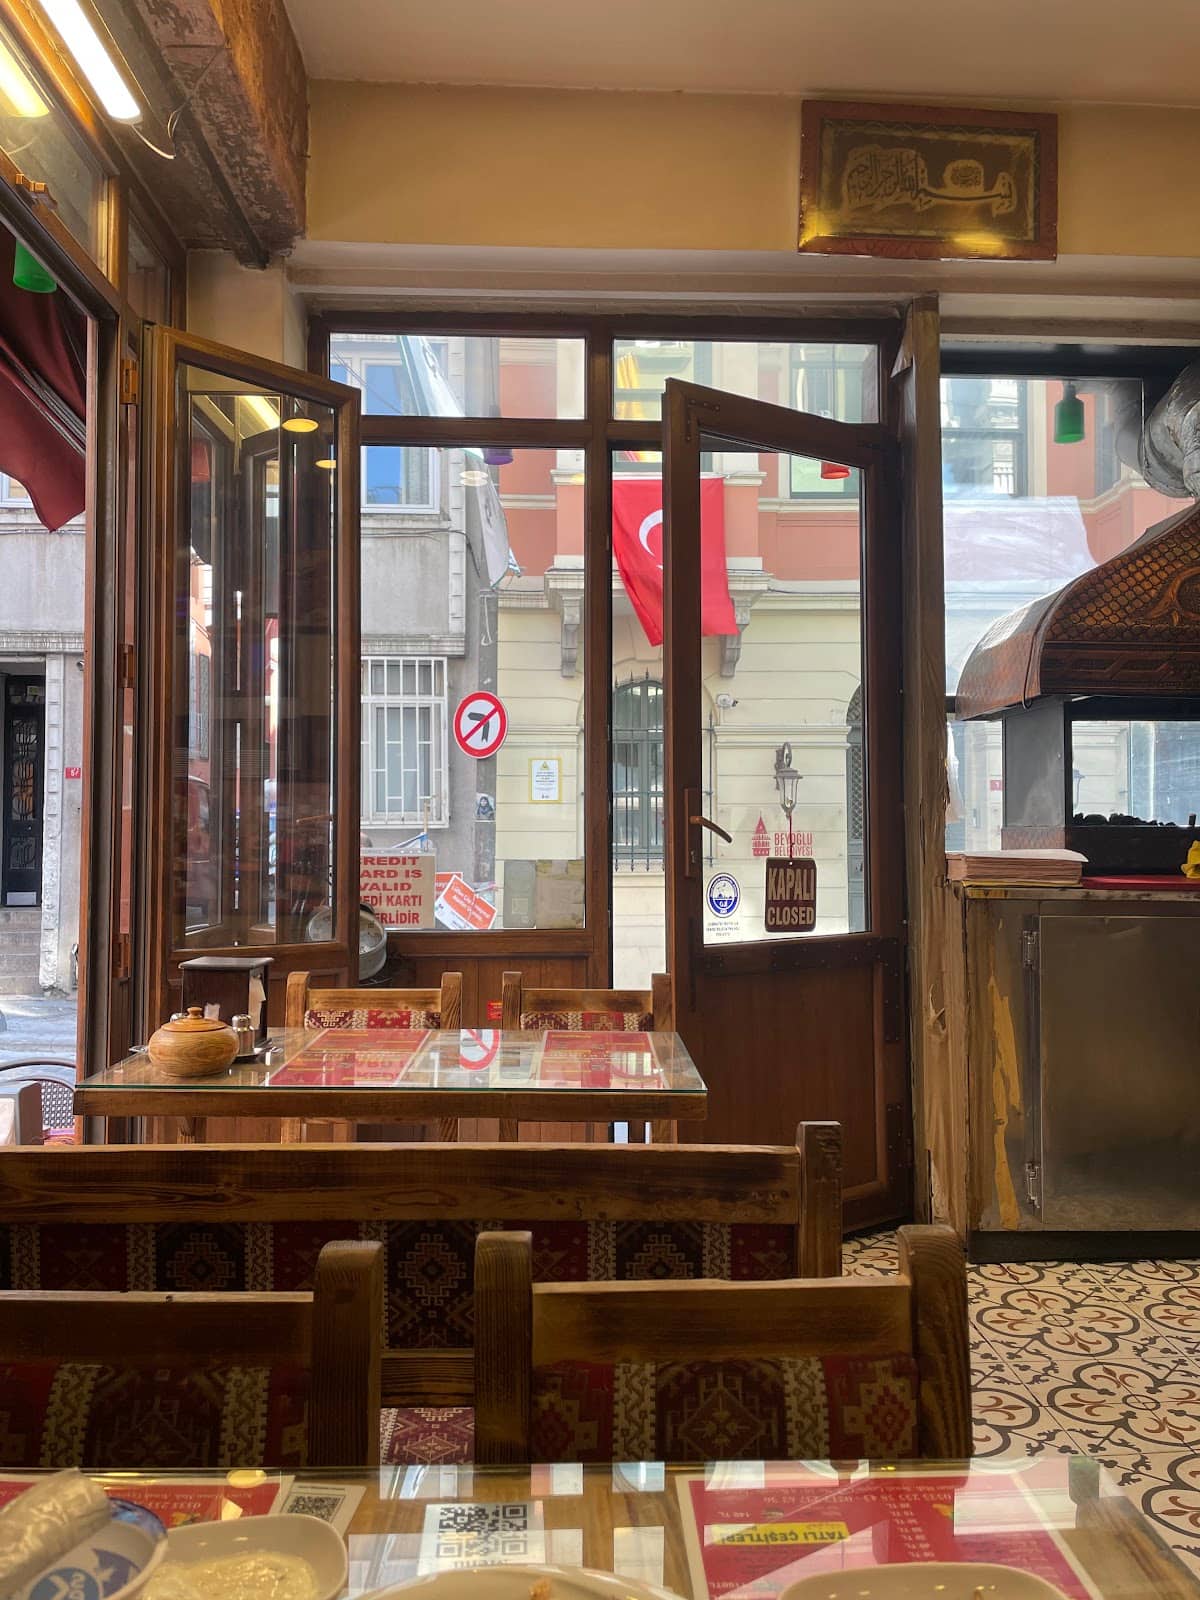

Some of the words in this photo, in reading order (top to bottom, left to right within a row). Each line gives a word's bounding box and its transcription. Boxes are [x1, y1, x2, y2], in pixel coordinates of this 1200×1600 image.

[360, 856, 419, 866] REDIT
[360, 869, 398, 879] ARD
[405, 869, 422, 879] IS
[767, 867, 815, 901] KAPALI
[360, 893, 382, 907] EDİ
[386, 895, 422, 907] KARTI
[375, 909, 420, 925] RLİDİR
[766, 906, 814, 926] CLOSED
[721, 1529, 799, 1545] ÇEŞİTLERİ
[803, 1530, 845, 1541] TATLI
